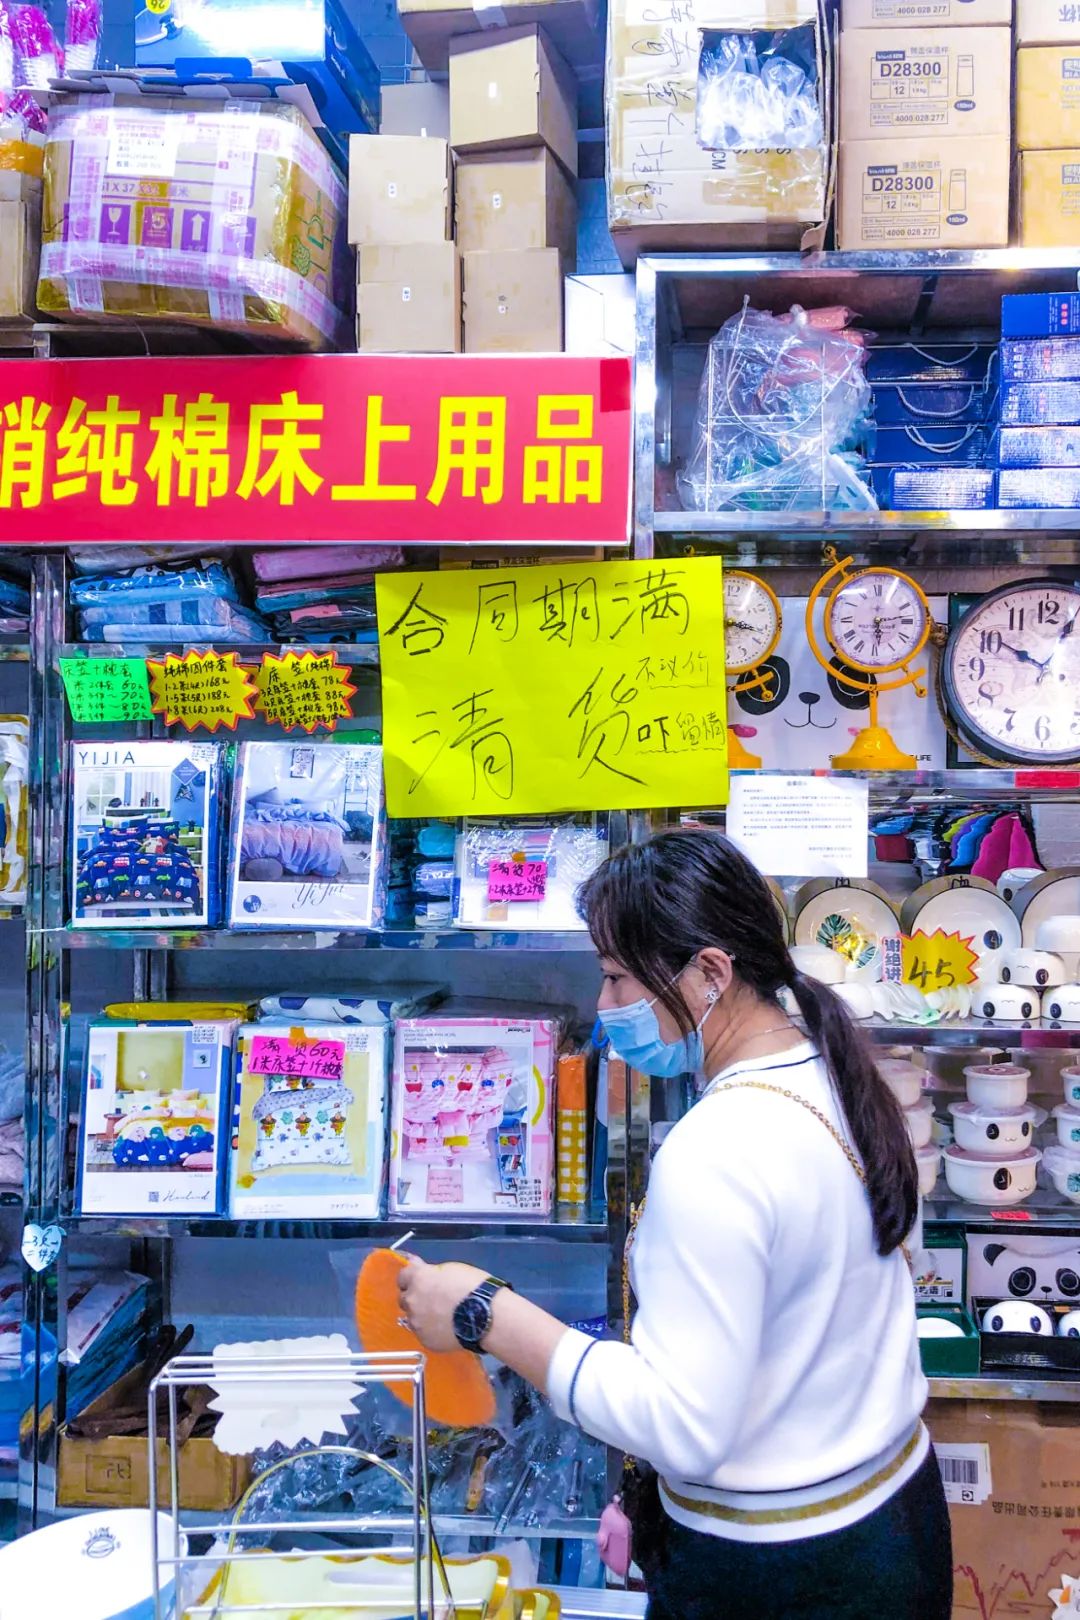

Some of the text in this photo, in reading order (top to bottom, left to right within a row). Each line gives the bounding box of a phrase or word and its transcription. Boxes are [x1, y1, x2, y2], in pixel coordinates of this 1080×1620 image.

[880, 62, 941, 77] D28300
[894, 86, 905, 95] 12
[872, 176, 934, 192] D28300
[886, 200, 897, 209] 12
[384, 569, 690, 656] 合同期满
[1009, 607, 1025, 631] 11
[1037, 599, 1060, 624] 12
[979, 629, 1003, 654] 10
[968, 656, 986, 682] 9
[976, 681, 1004, 708] 8
[1003, 708, 1017, 732] 7
[1034, 715, 1051, 742] 6
[78, 750, 135, 765] YIJIA
[908, 956, 956, 988] 45
